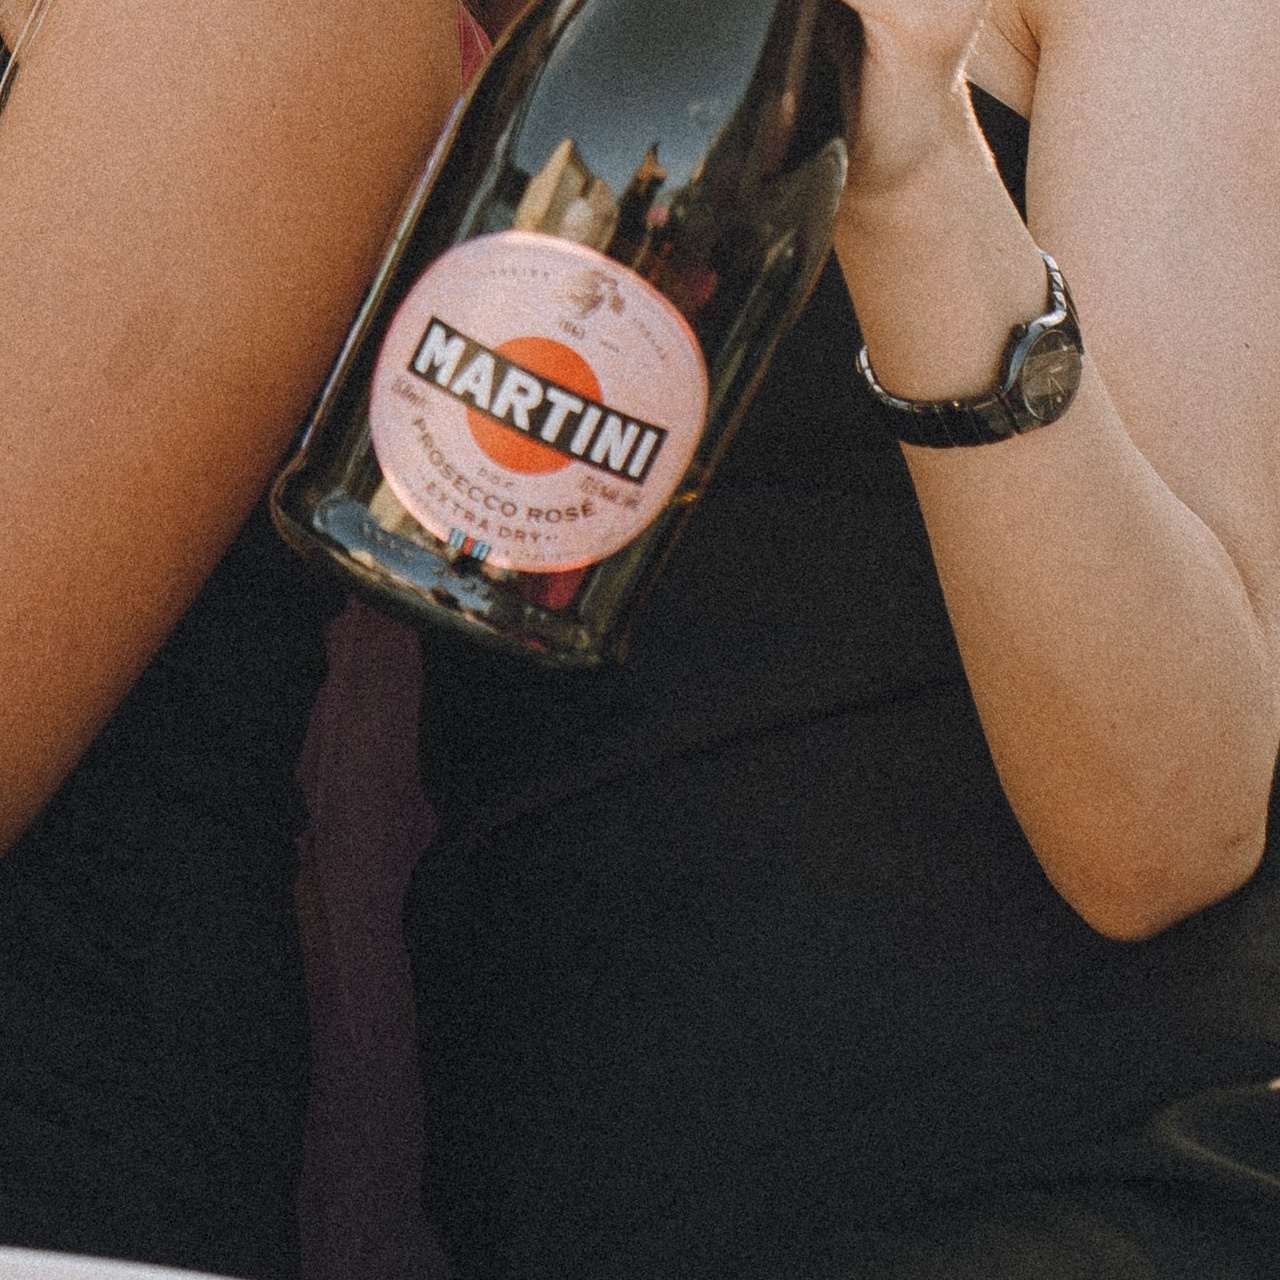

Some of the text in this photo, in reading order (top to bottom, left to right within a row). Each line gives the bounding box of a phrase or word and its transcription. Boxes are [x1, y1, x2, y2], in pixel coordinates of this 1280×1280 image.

[413, 321, 657, 479] MARTINI
[413, 416, 518, 518] PROSECCO
[425, 481, 542, 543] EXTRA DRY
